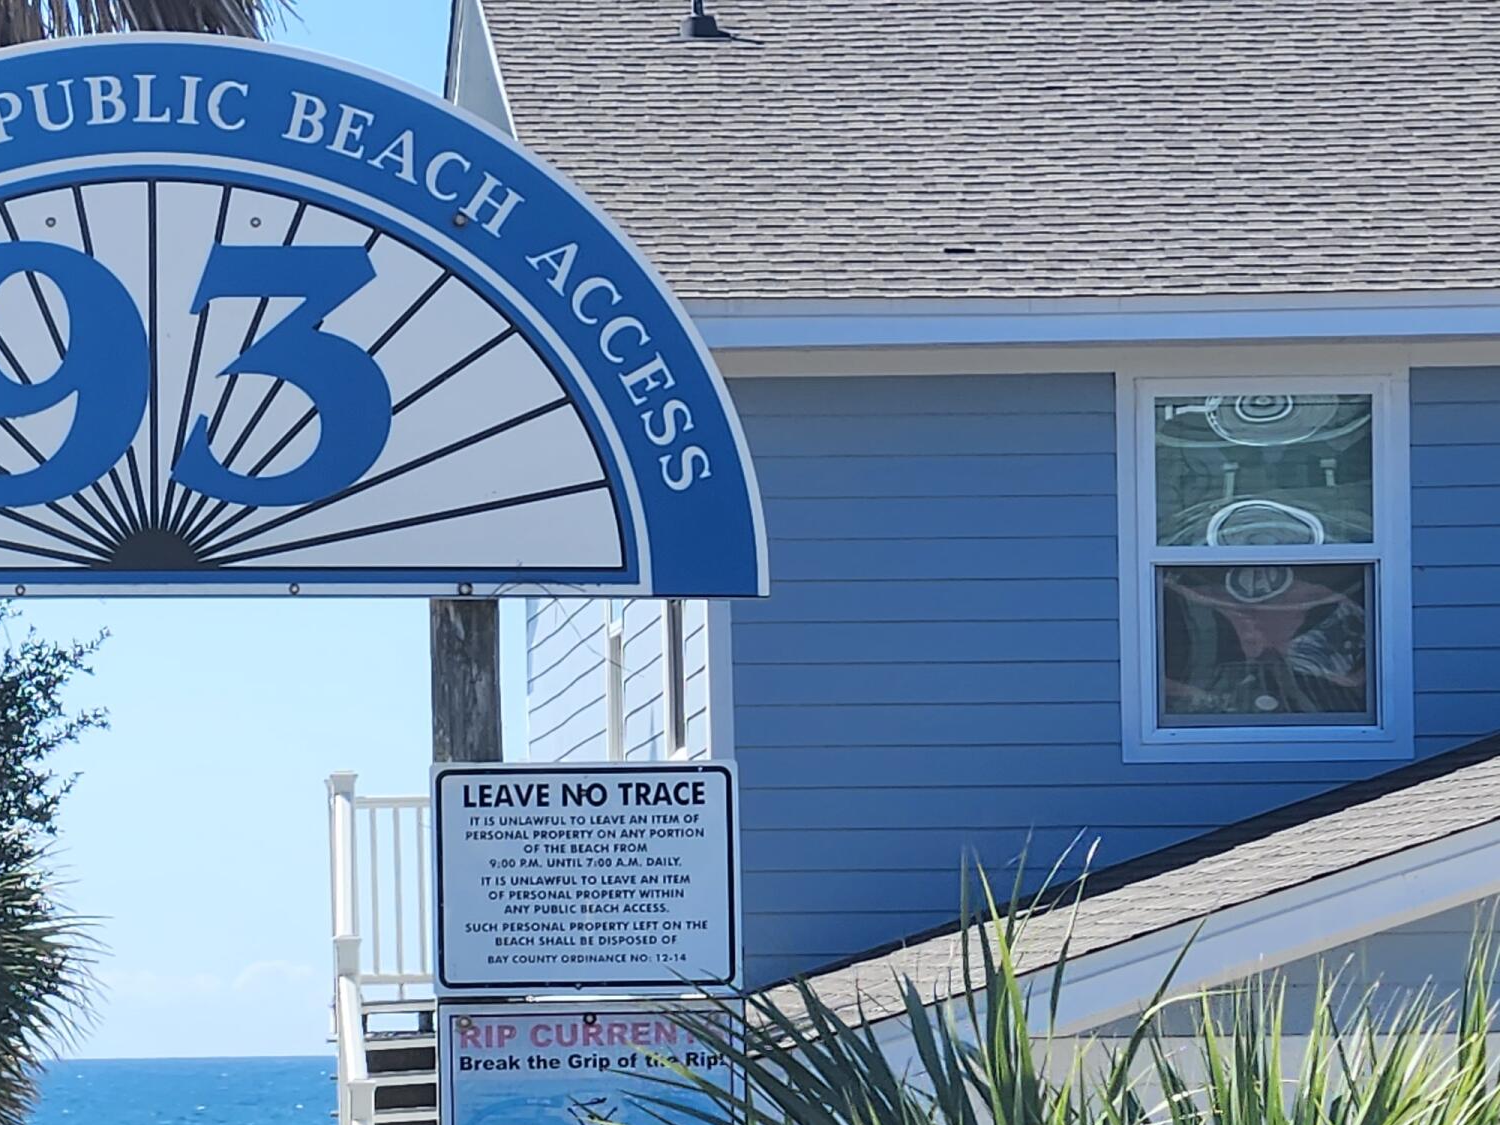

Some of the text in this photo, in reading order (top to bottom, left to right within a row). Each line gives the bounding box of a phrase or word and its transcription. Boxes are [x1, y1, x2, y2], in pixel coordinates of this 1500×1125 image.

[281, 91, 525, 238] BEACH
[525, 242, 712, 492] ACCESS
[463, 782, 705, 807] LEAVE NO TRACE
[469, 814, 699, 826] IT IS UNLAWFUL TO LEAVE AN ITEM OF
[465, 828, 704, 840] PERSONAL PROPERTY ON ANY PORTION
[523, 843, 647, 854] OF THE BEACH FROM
[489, 857, 682, 868] 9:00 P.M. UNTIL 7:00 A.M. DAILY.
[480, 874, 690, 886] IT IS UNLAWFUL TO LEAVE AN ITEM
[488, 889, 684, 900] OF PERSONAL PROPERTY WITHIN
[504, 903, 670, 914] ANY PUBLIC BEACH ACCESS.
[465, 920, 708, 932] SUCH PERSONAL PROPERTY LEFT ON THE
[495, 935, 677, 947] BEACH SHALL BE DISPOSED OF
[460, 1020, 725, 1049] RIP CURREN
[459, 1054, 520, 1071] Break
[527, 1054, 561, 1069] the
[568, 1053, 610, 1072] Grip
[618, 1053, 637, 1067] of
